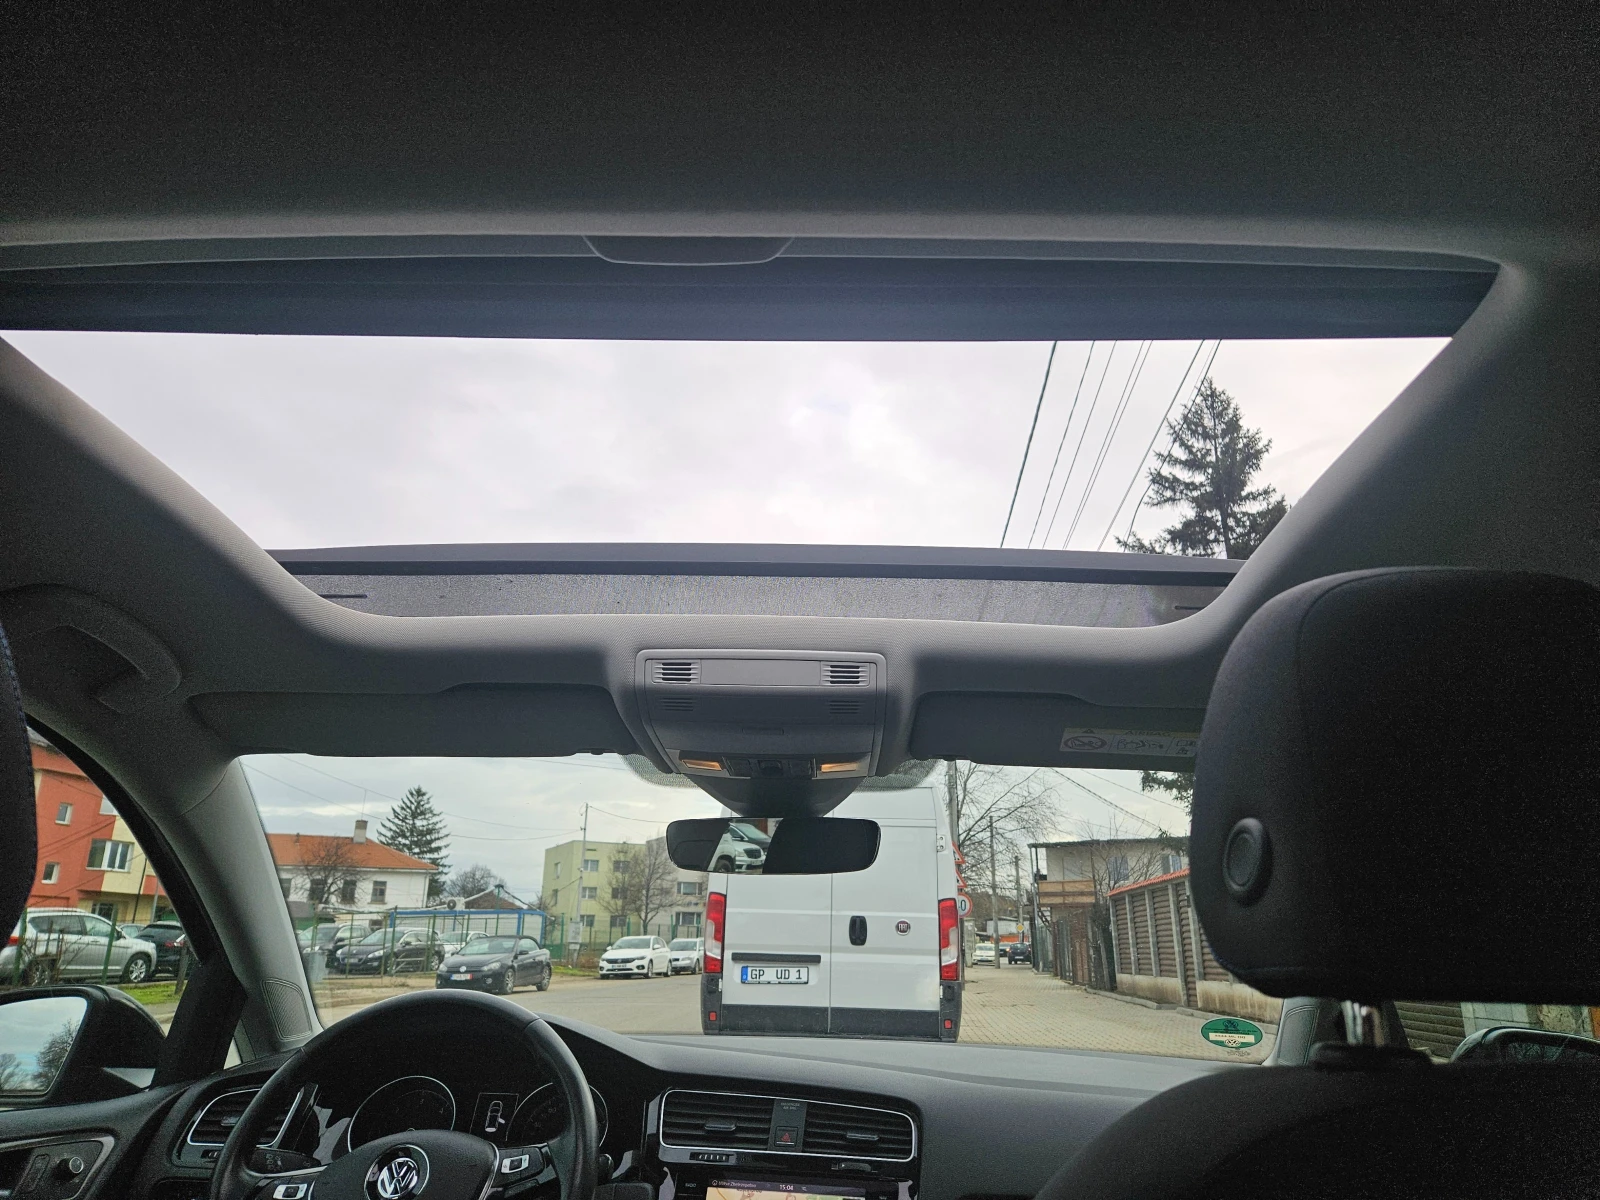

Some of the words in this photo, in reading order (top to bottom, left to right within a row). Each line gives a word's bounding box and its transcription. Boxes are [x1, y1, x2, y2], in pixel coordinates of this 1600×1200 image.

[750, 968, 765, 980] GP
[775, 968, 790, 980] UD
[795, 969, 802, 980] 1
